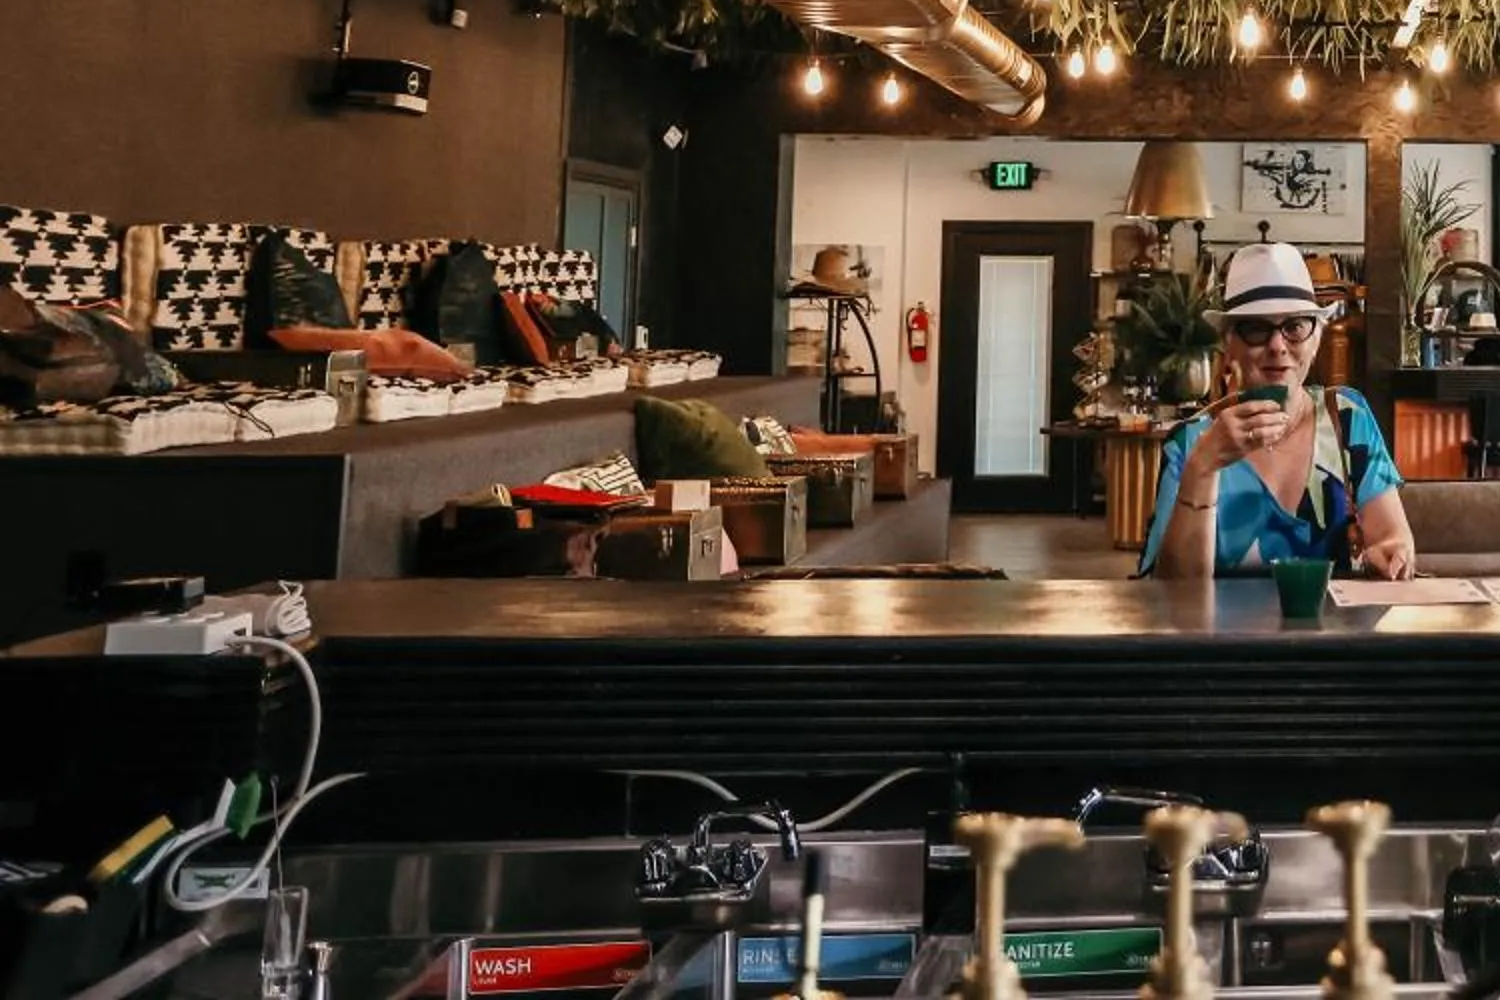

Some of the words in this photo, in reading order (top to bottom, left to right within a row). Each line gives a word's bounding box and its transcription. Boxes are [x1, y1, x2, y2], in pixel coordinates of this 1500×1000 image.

[997, 163, 1027, 187] EXIT
[1005, 942, 1075, 960] ANITIZE
[475, 957, 531, 976] WASH
